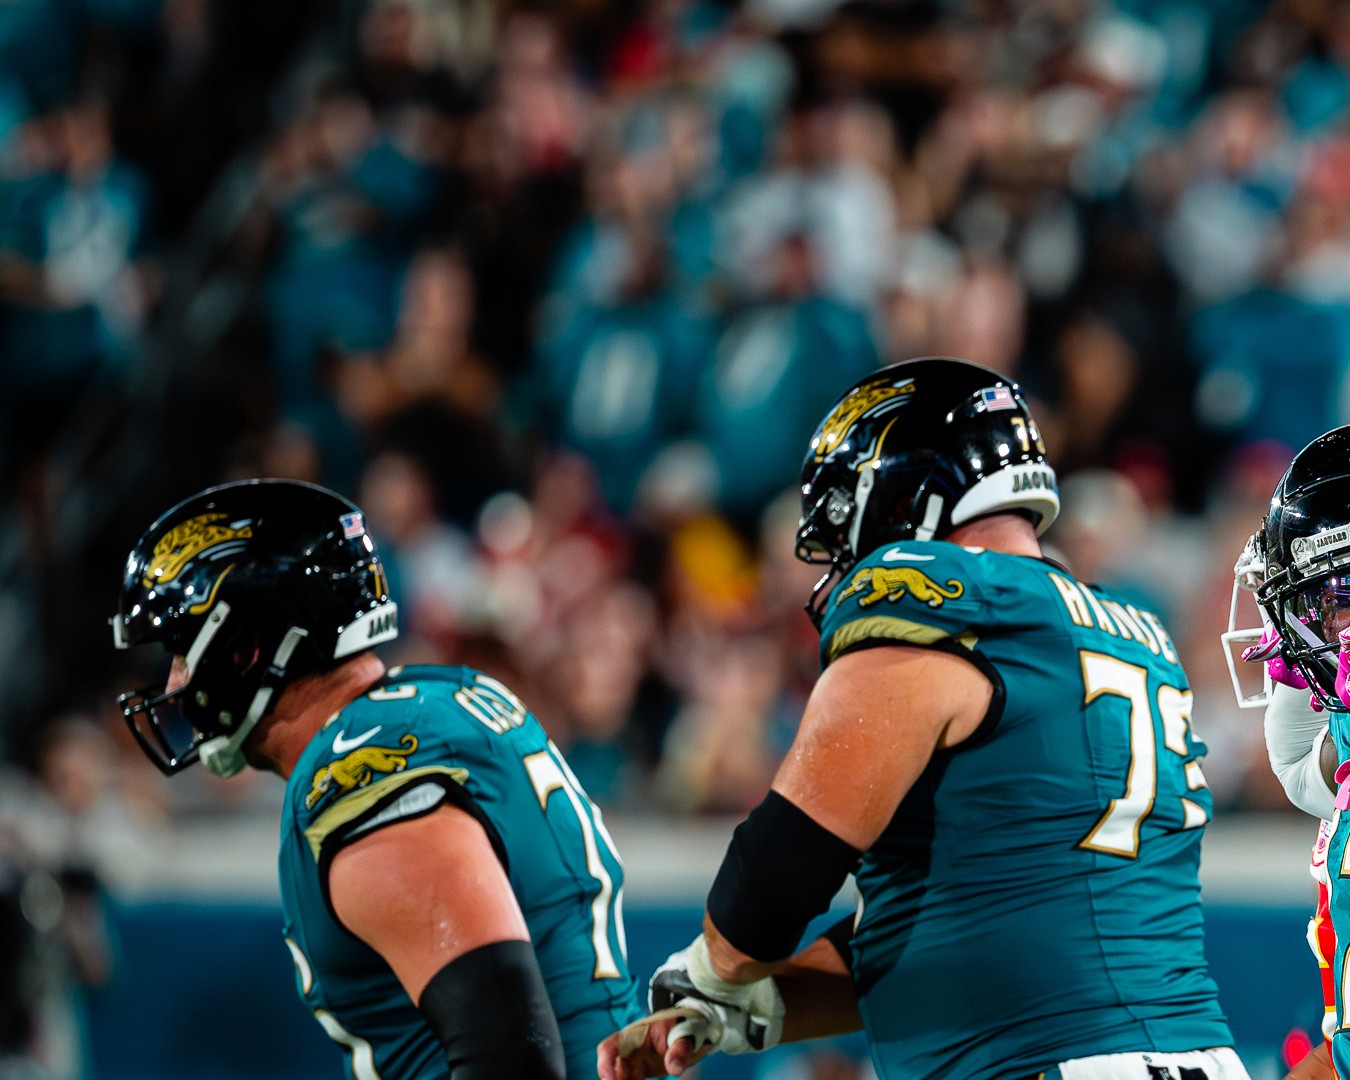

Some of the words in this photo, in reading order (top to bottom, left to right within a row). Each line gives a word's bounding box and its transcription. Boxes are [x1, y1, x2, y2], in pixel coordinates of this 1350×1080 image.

[1316, 531, 1347, 548] JAGUARS
[368, 563, 389, 600] 7
[522, 737, 628, 979] 7
